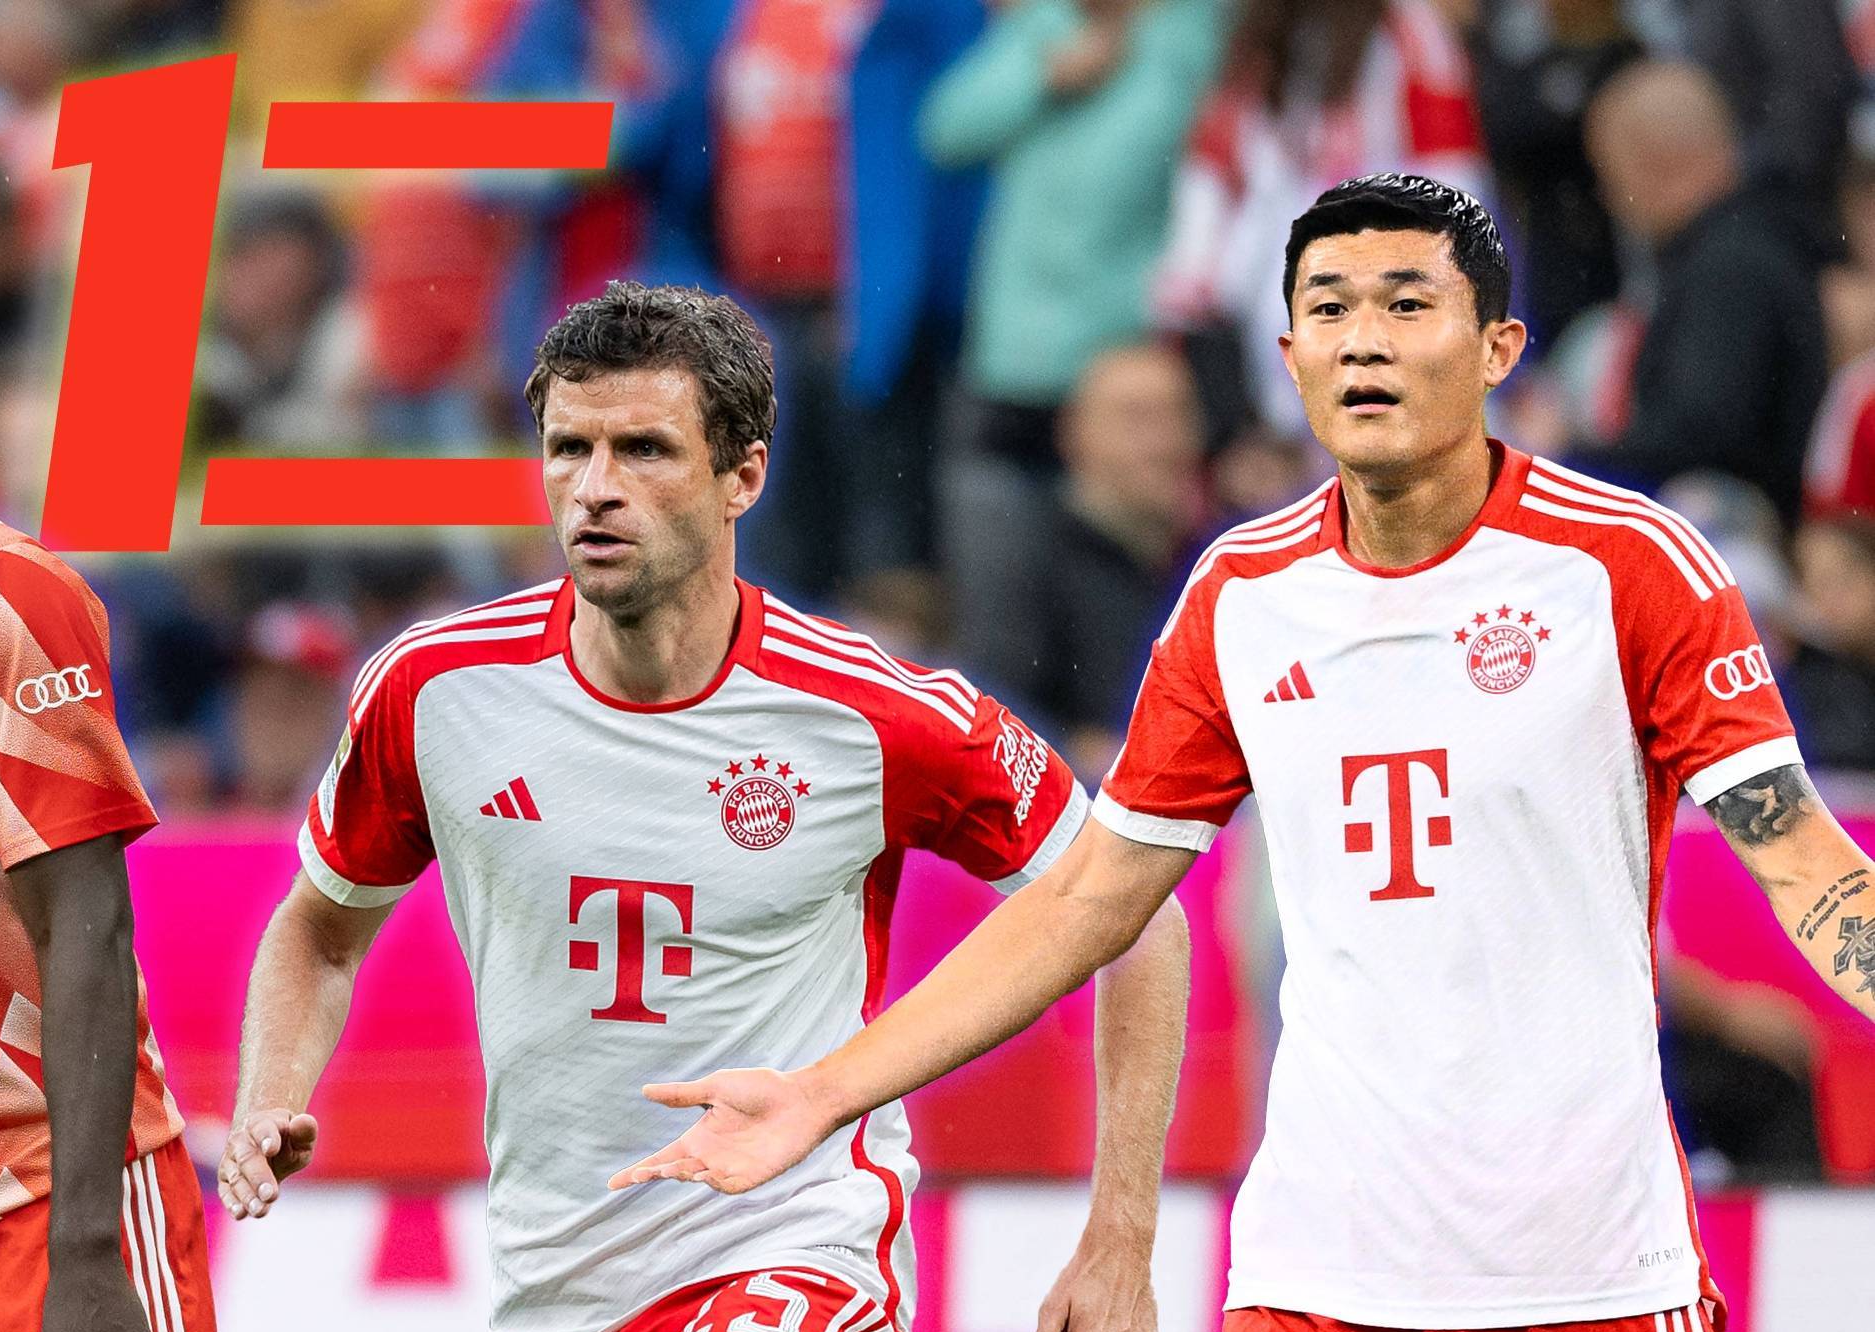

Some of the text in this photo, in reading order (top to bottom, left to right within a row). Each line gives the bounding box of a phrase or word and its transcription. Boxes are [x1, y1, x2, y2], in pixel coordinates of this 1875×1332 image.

[1487, 630, 1530, 654] BAYERN
[728, 782, 789, 809] FC BAYERN
[1341, 747, 1449, 902] T
[568, 875, 695, 1024] T
